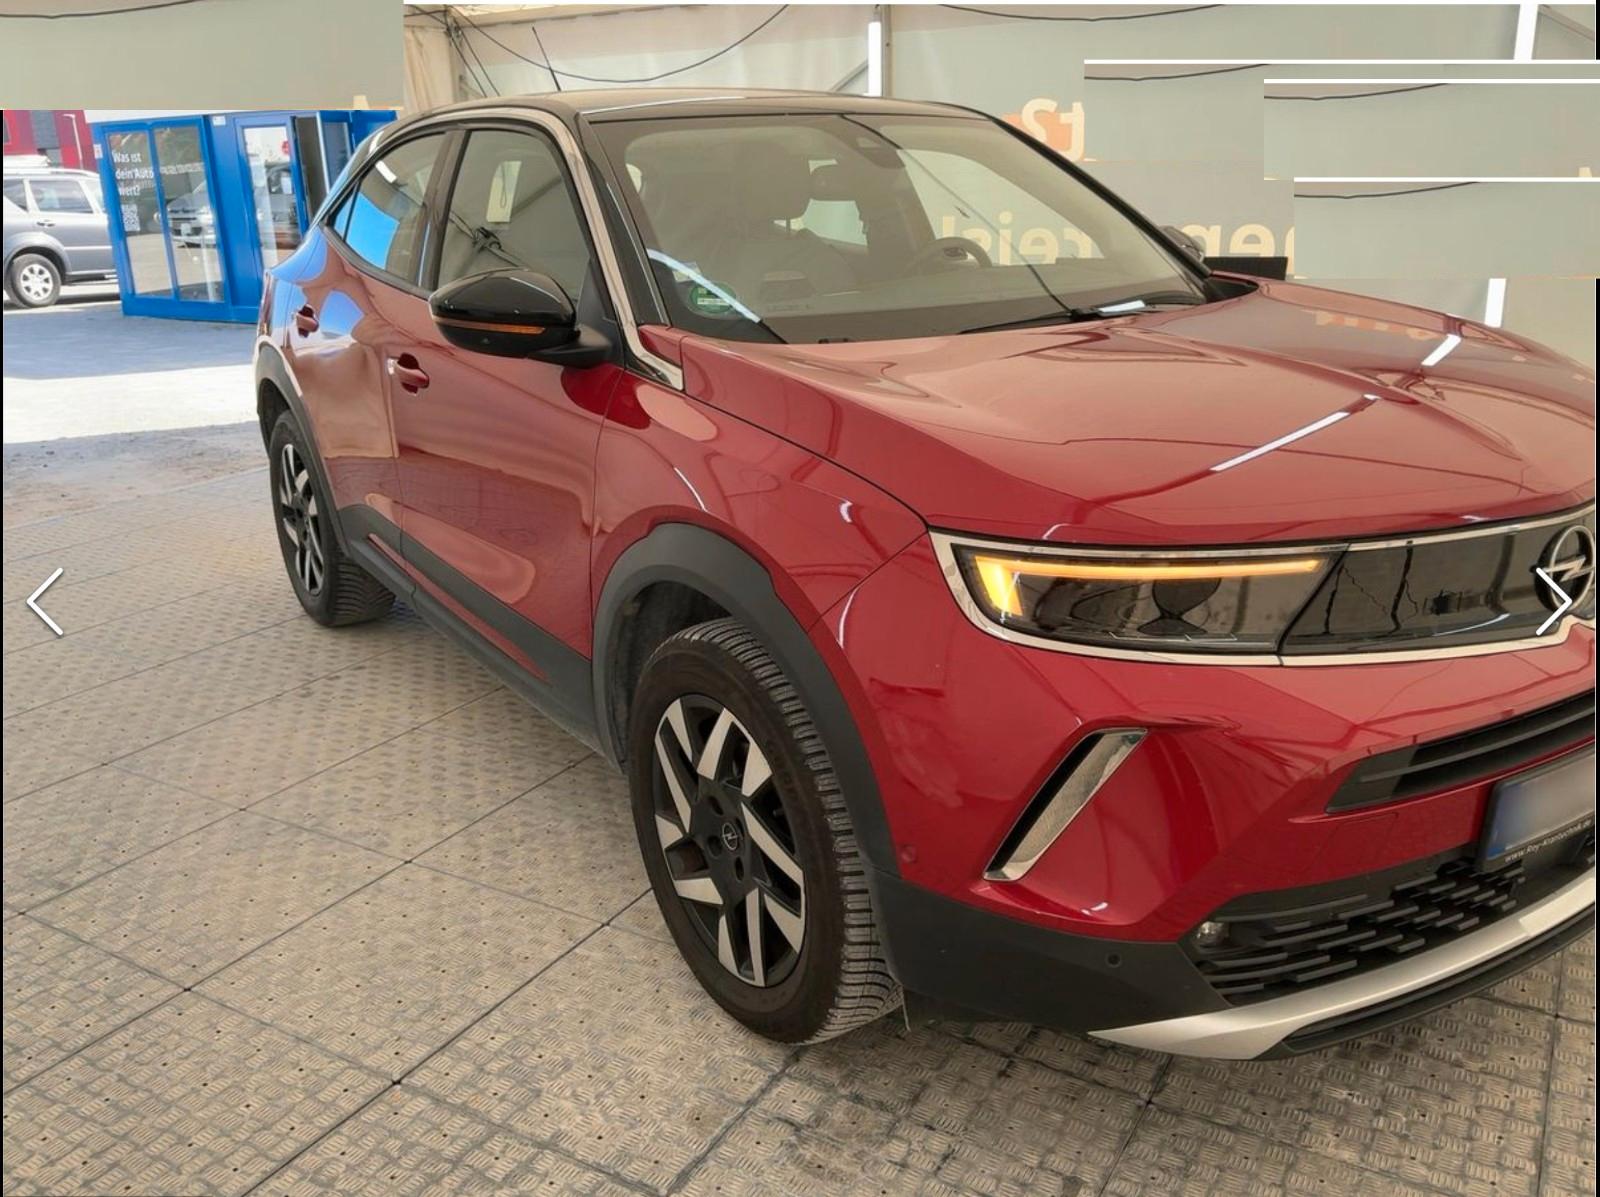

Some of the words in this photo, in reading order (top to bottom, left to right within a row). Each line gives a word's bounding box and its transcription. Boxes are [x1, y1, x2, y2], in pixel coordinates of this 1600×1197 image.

[112, 150, 130, 163] Was
[130, 153, 142, 163] ist
[115, 168, 133, 179] dein
[133, 168, 154, 179] Auto
[118, 184, 140, 196] wert?
